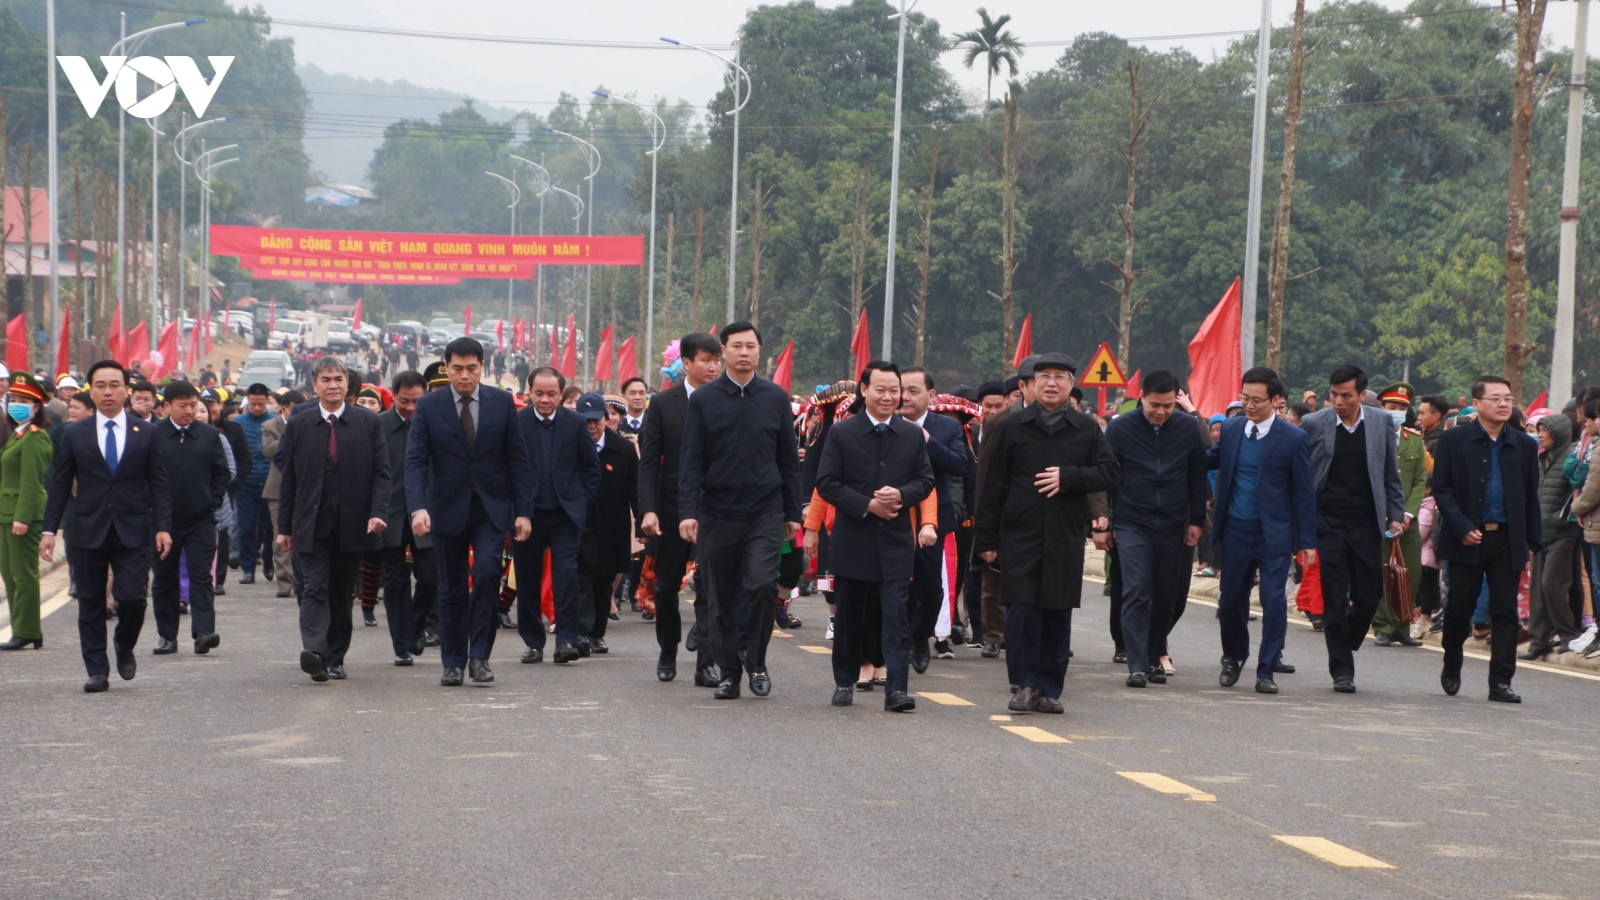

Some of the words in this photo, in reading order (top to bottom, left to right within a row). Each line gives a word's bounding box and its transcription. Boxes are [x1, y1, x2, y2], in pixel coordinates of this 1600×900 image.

[260, 233, 293, 249] ĐẢNG
[300, 236, 332, 252] CỘNG
[338, 236, 363, 251] SẢN
[369, 238, 394, 254] VIỆT
[400, 241, 427, 253] NAM
[433, 242, 472, 255] QUANG
[478, 243, 505, 255] VINH
[512, 241, 547, 255] MUÔN
[553, 242, 580, 256] NĂM
[585, 244, 590, 257] !
